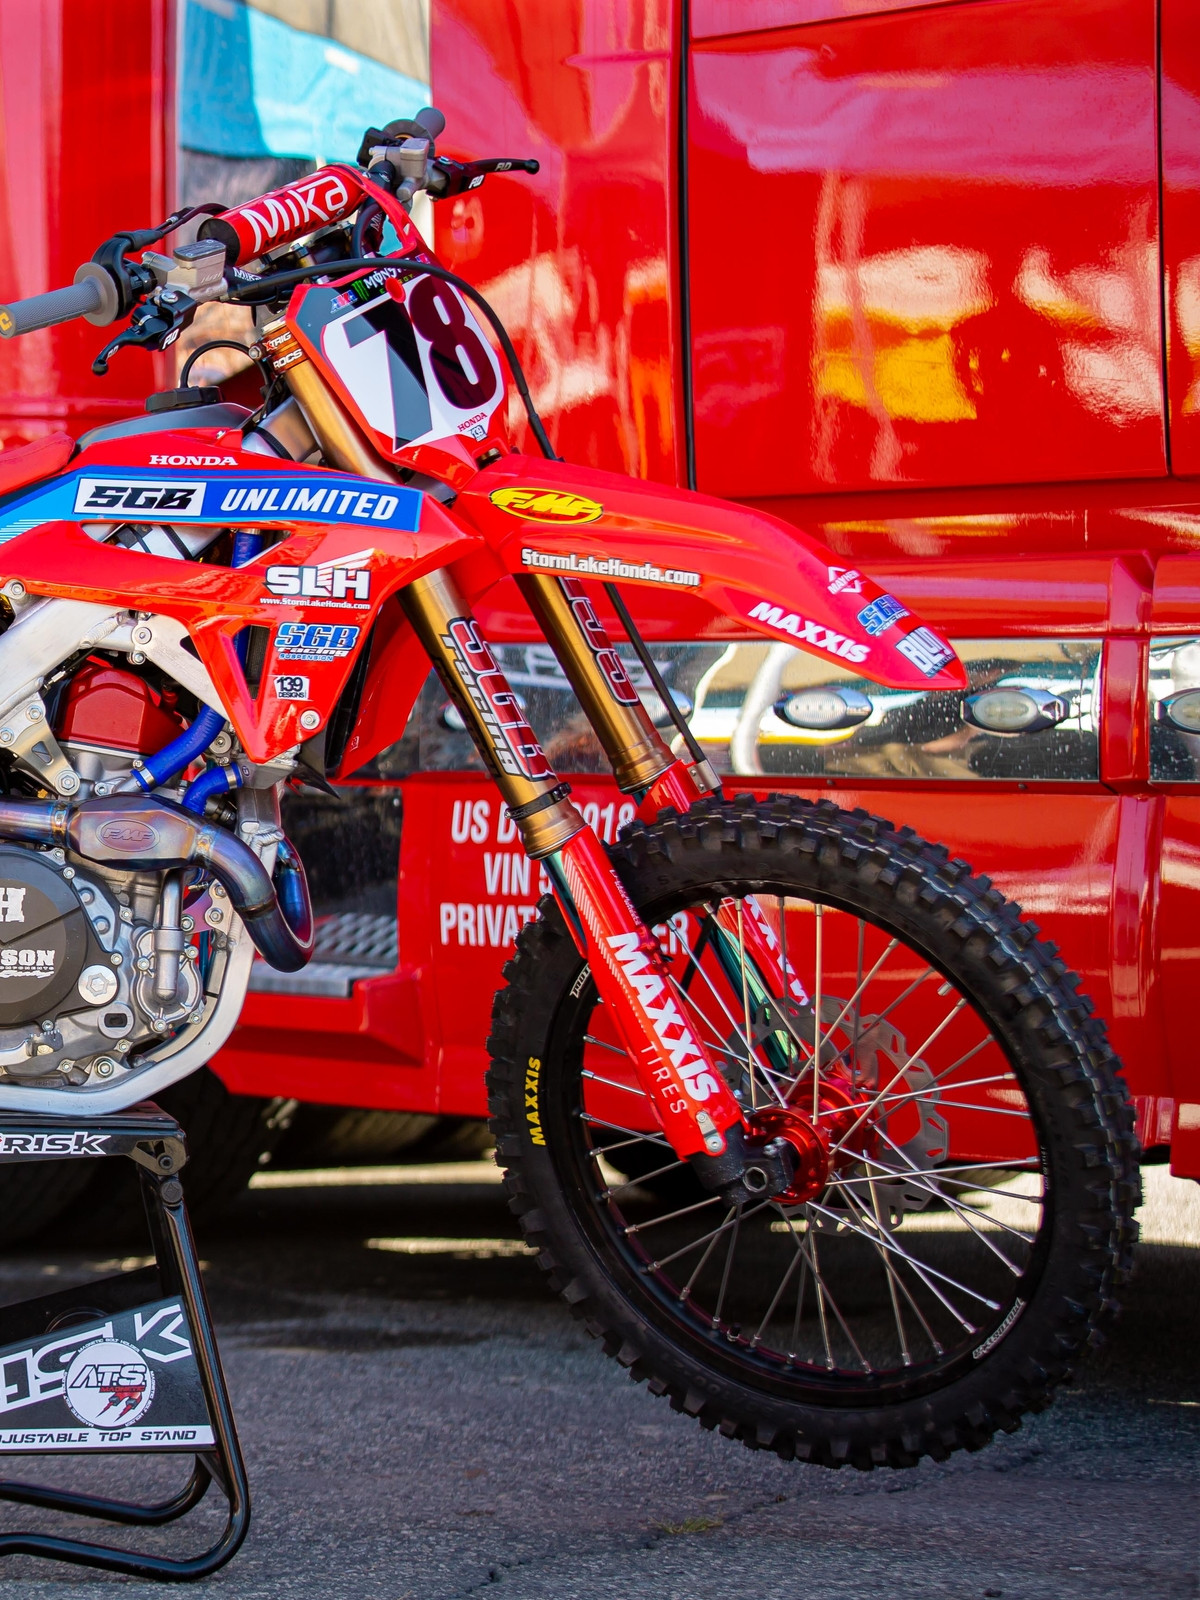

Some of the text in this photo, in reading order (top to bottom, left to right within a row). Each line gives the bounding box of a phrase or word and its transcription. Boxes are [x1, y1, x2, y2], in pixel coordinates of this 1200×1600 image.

[239, 174, 349, 253] Mika
[263, 332, 292, 352] XTRIG
[273, 348, 304, 369] ROCS
[342, 274, 498, 450] 78
[457, 412, 488, 433] HONDA
[149, 454, 238, 467] HONDA
[84, 485, 400, 522] SGB UNLIMITED
[491, 489, 604, 517] FMF
[265, 564, 371, 600] SLH
[521, 547, 701, 588] StormLakeHonda.com
[259, 597, 371, 610] www.StormLakeHonda.com
[274, 622, 361, 651] SGB
[748, 602, 872, 663] MAXXIS
[276, 676, 304, 692] 139
[438, 633, 523, 775] racing
[103, 828, 154, 842] FMF
[451, 800, 492, 844] US
[483, 851, 532, 896] VIN
[606, 931, 721, 1103] MAXXIS
[641, 1041, 689, 1115] TIRES
[524, 1056, 547, 1147] MAXXIS
[1, 1131, 112, 1156] RISK
[98, 1430, 132, 1443] TOP
[140, 1429, 197, 1442] STAND
